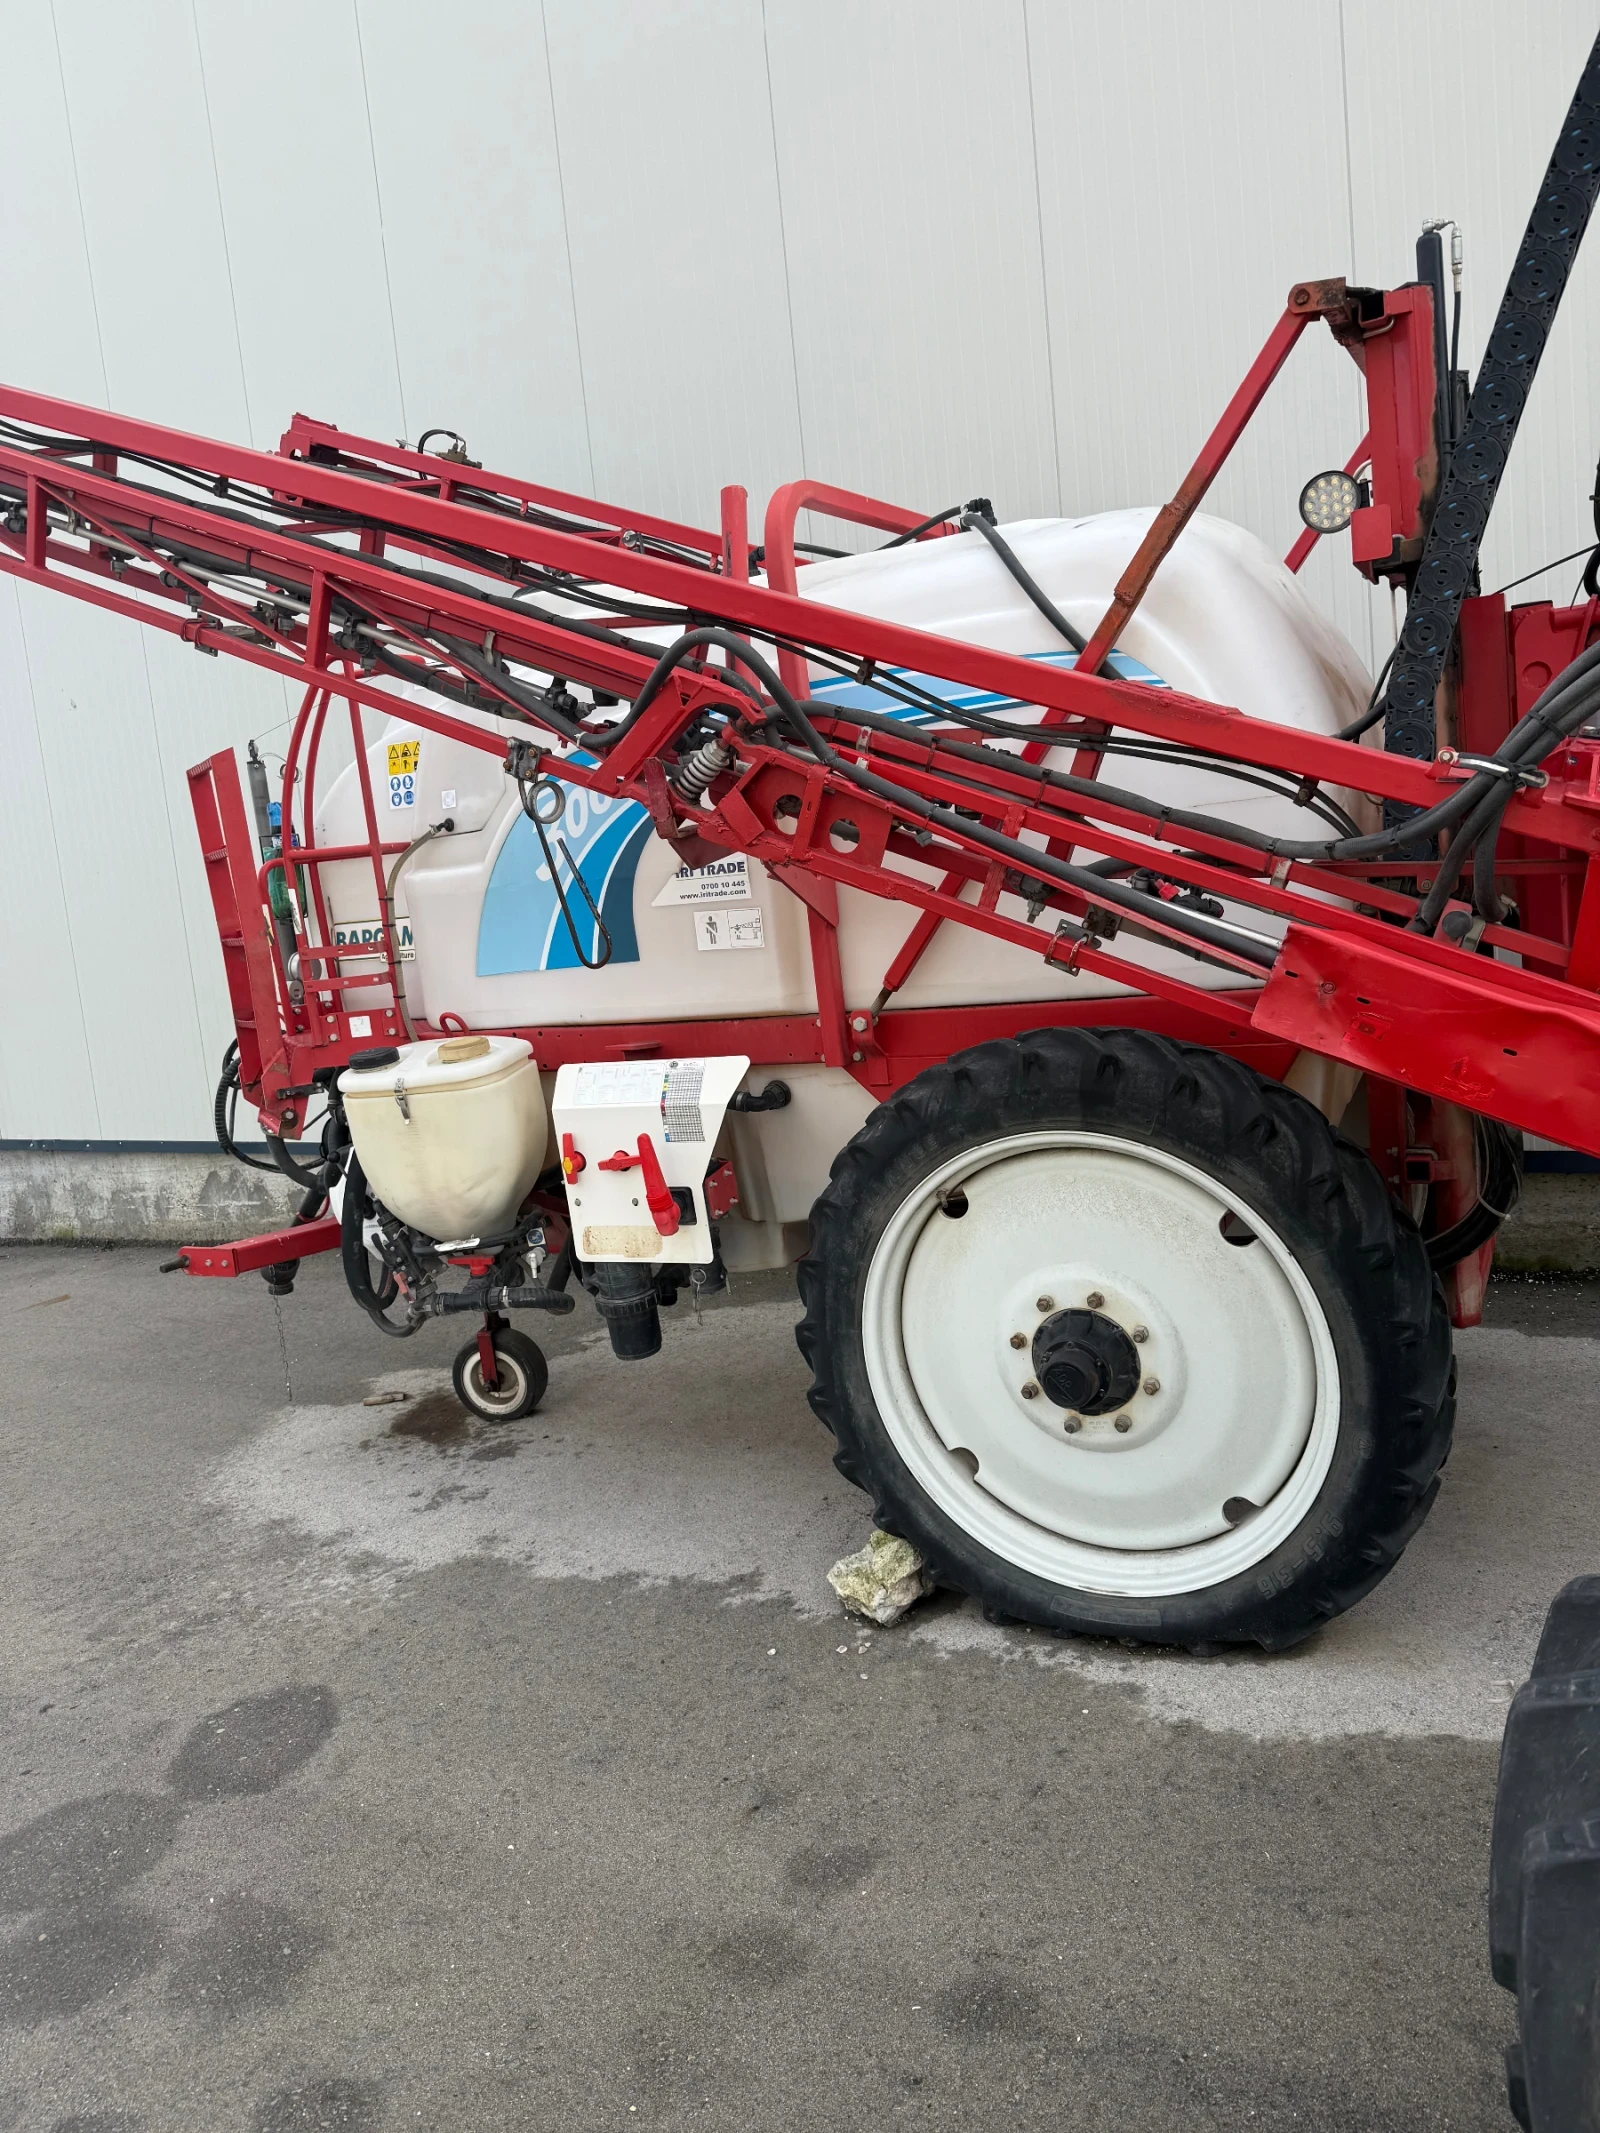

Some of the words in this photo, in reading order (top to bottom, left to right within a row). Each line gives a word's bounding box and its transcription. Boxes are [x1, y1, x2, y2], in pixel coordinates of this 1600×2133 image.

[700, 861, 746, 877] TRADE
[701, 882, 719, 890] 0700
[721, 881, 730, 889] 10
[731, 880, 746, 888] 445
[679, 888, 747, 900] www.iritrade.com
